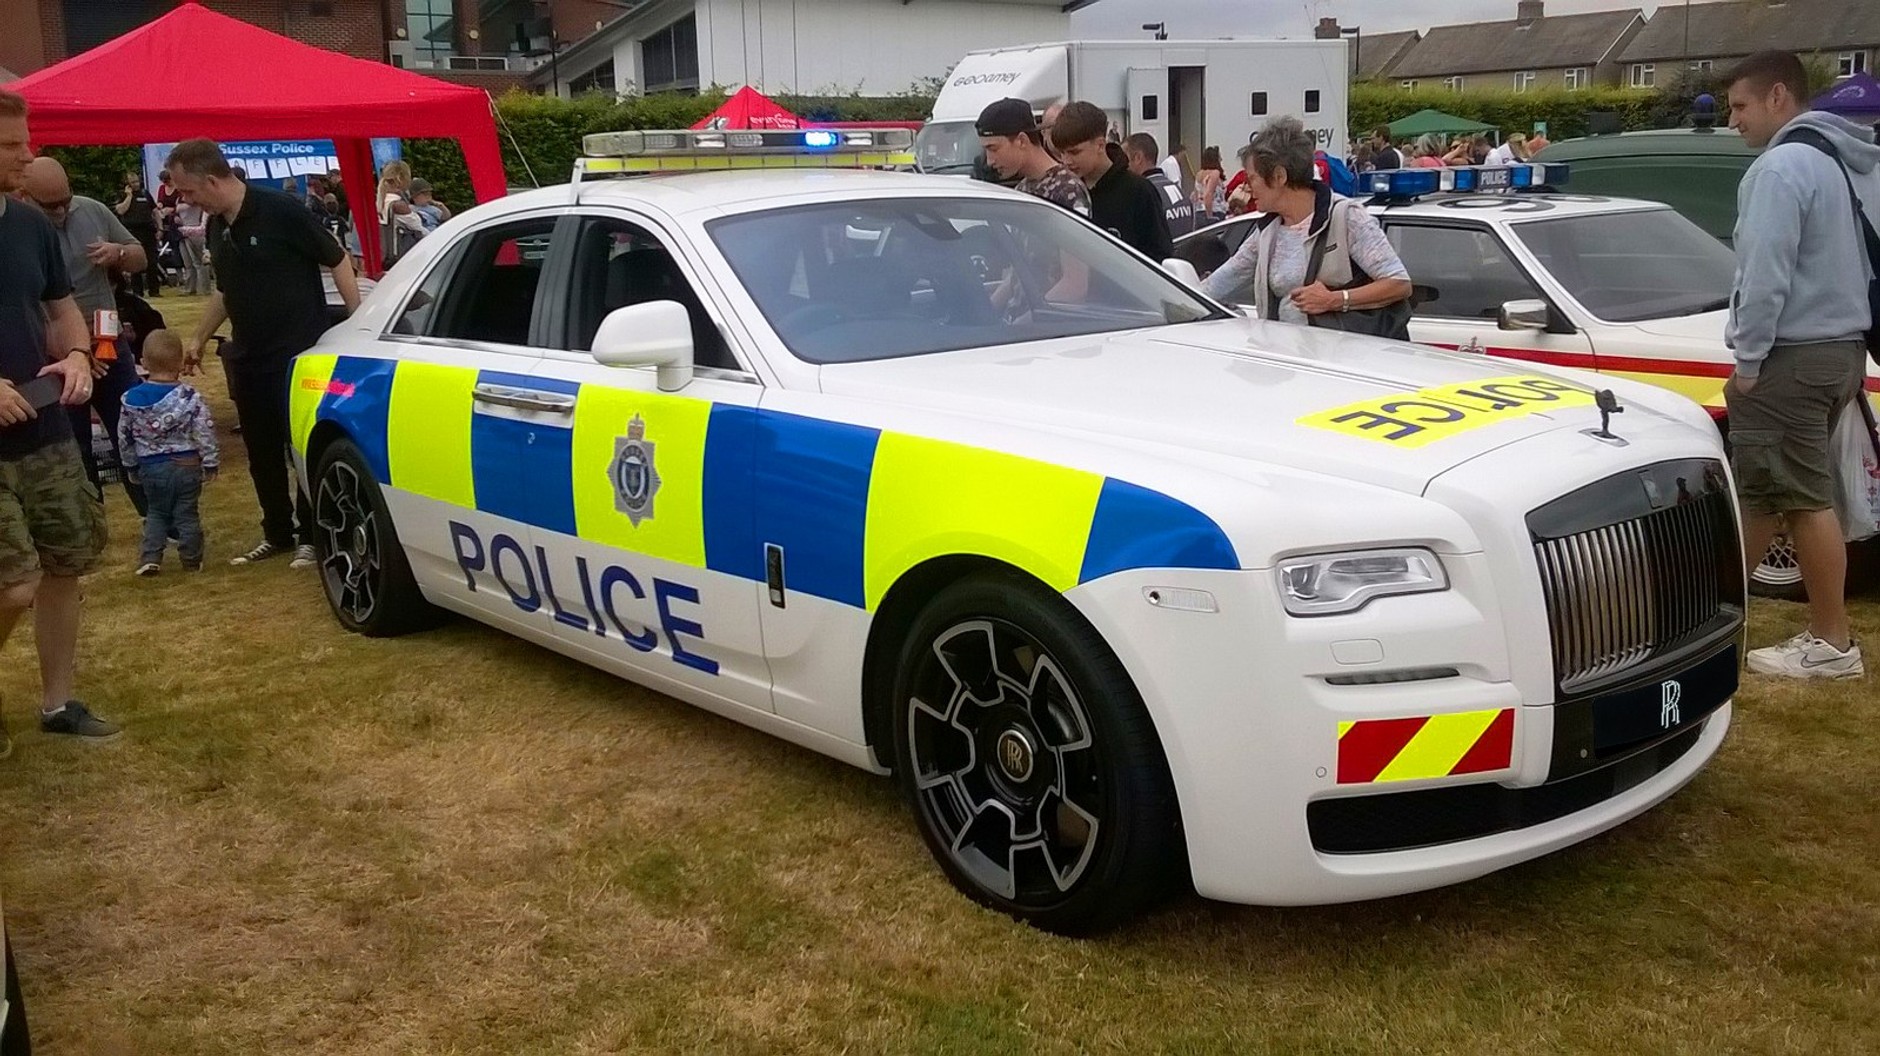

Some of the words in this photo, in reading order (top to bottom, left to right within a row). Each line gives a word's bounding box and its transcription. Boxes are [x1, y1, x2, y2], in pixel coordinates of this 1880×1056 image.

[218, 143, 268, 154] Sussex
[271, 142, 315, 154] Police
[1480, 169, 1508, 186] POLICE
[1165, 206, 1191, 220] AVIV
[448, 519, 720, 677] POLICE
